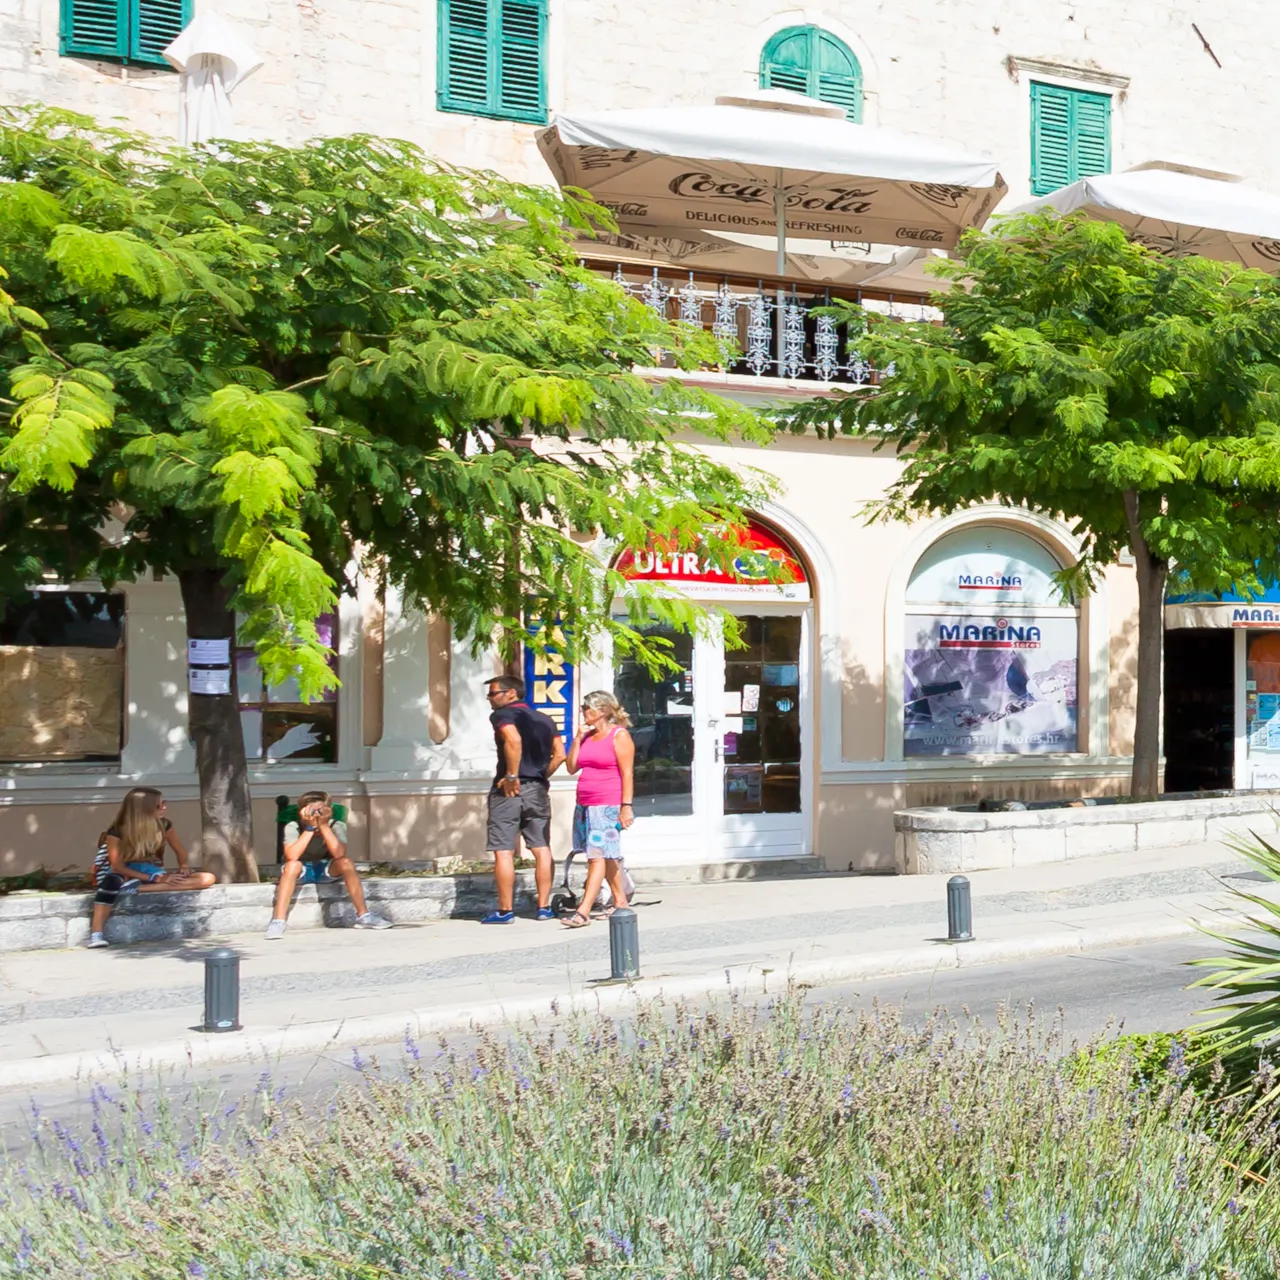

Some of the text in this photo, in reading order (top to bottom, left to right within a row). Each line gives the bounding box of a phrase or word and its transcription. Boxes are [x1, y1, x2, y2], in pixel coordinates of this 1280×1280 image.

[685, 210, 759, 227] DELICIOUS
[783, 219, 863, 235] REFRESHING
[634, 550, 723, 576] ULTRA
[921, 733, 1060, 746] www.mariastores.hr
